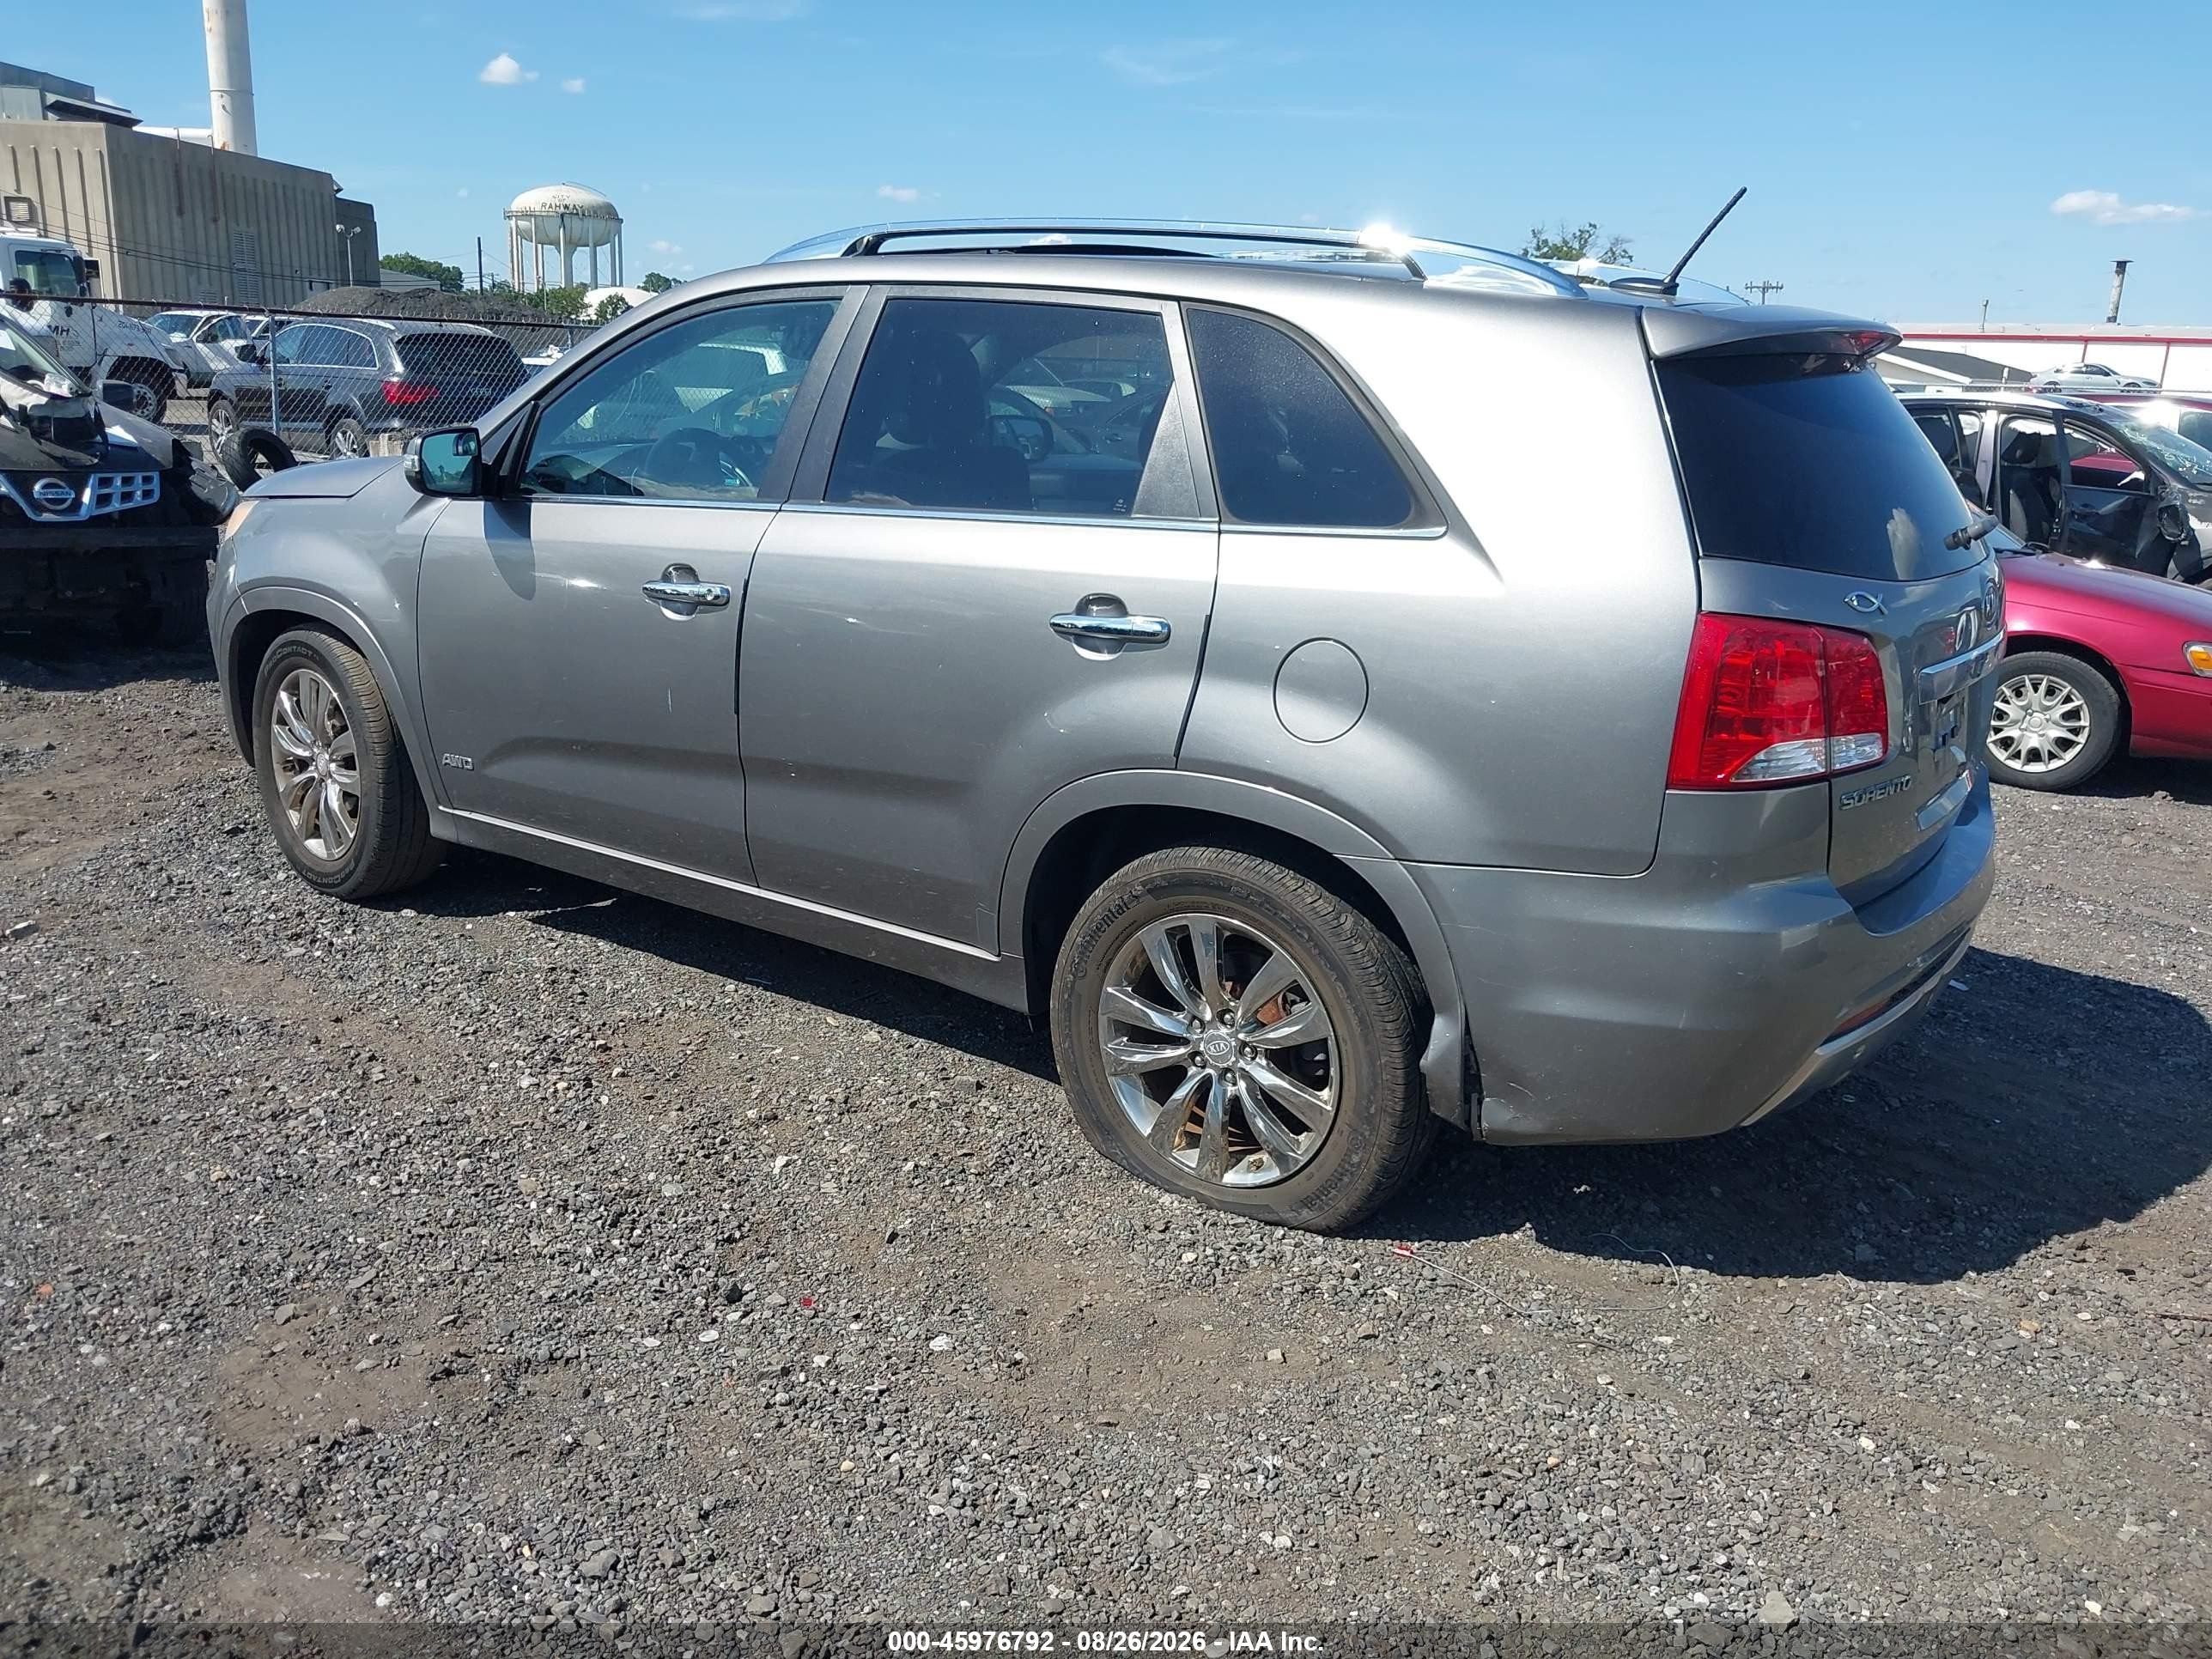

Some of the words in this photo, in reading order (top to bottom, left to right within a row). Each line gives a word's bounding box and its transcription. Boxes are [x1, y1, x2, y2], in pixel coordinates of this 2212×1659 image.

[541, 202, 585, 211] RAHWAY
[442, 753, 473, 770] AWD
[1839, 775, 1911, 811] SORENTO
[1210, 1042, 1226, 1053] KIA
